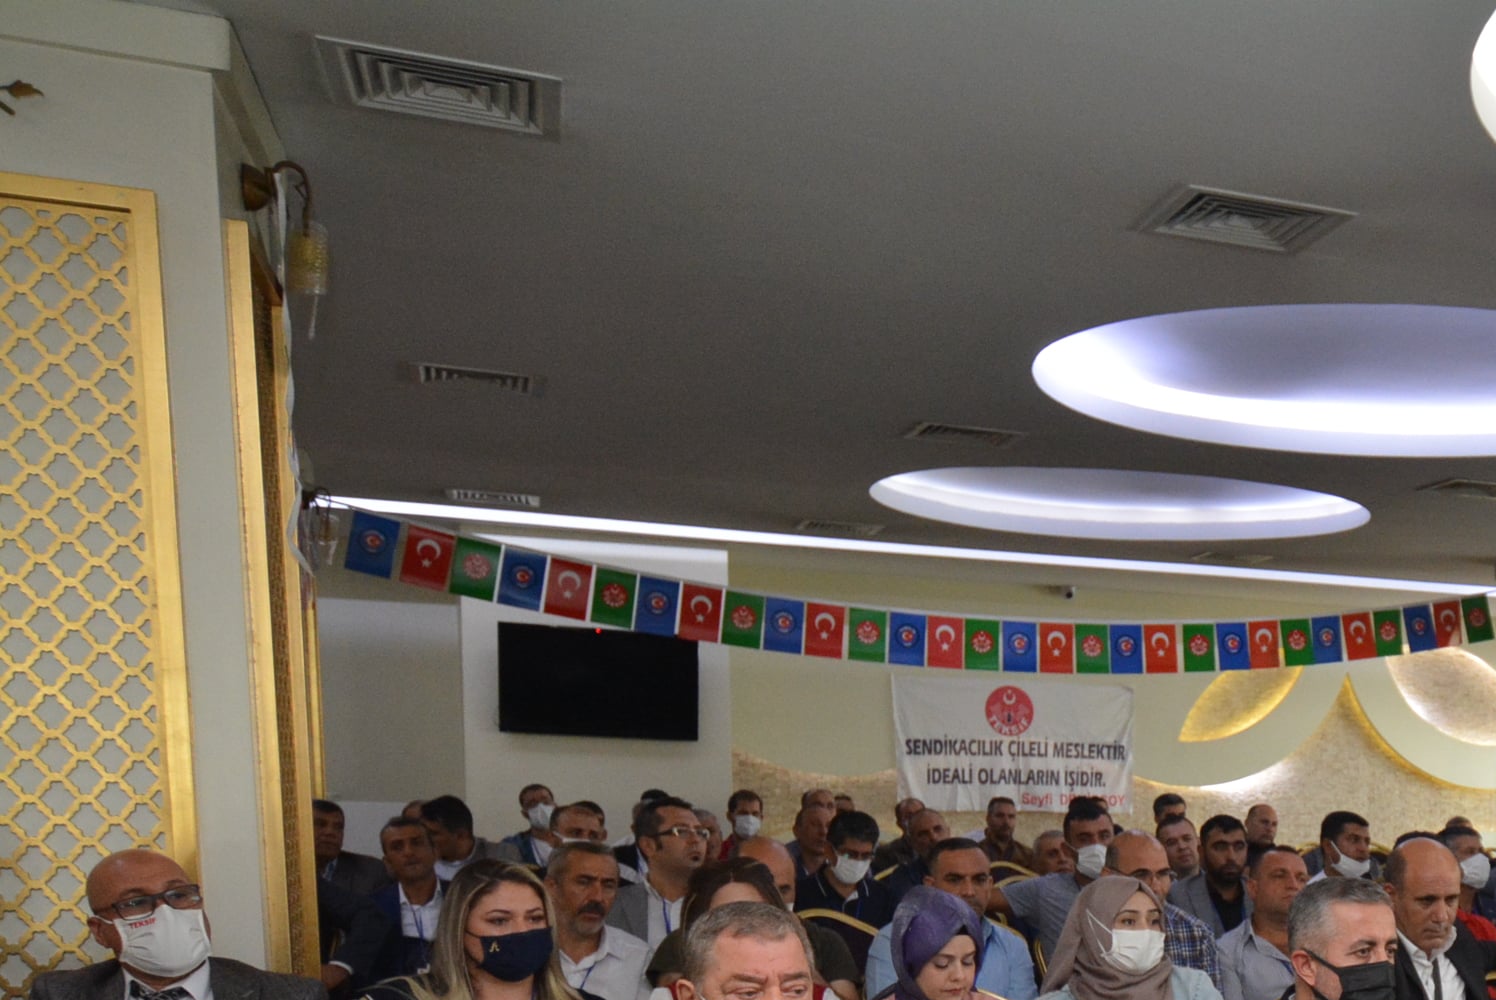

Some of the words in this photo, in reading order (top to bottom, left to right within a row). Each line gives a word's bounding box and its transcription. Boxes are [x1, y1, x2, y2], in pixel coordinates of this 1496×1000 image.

[905, 734, 1003, 757] SENDİKACILIK
[1008, 737, 1048, 762] ÇİLELİ
[1052, 739, 1126, 761] MESLEKTİR
[927, 763, 973, 785] İDEALİ
[978, 767, 1060, 787] OLANLARIN
